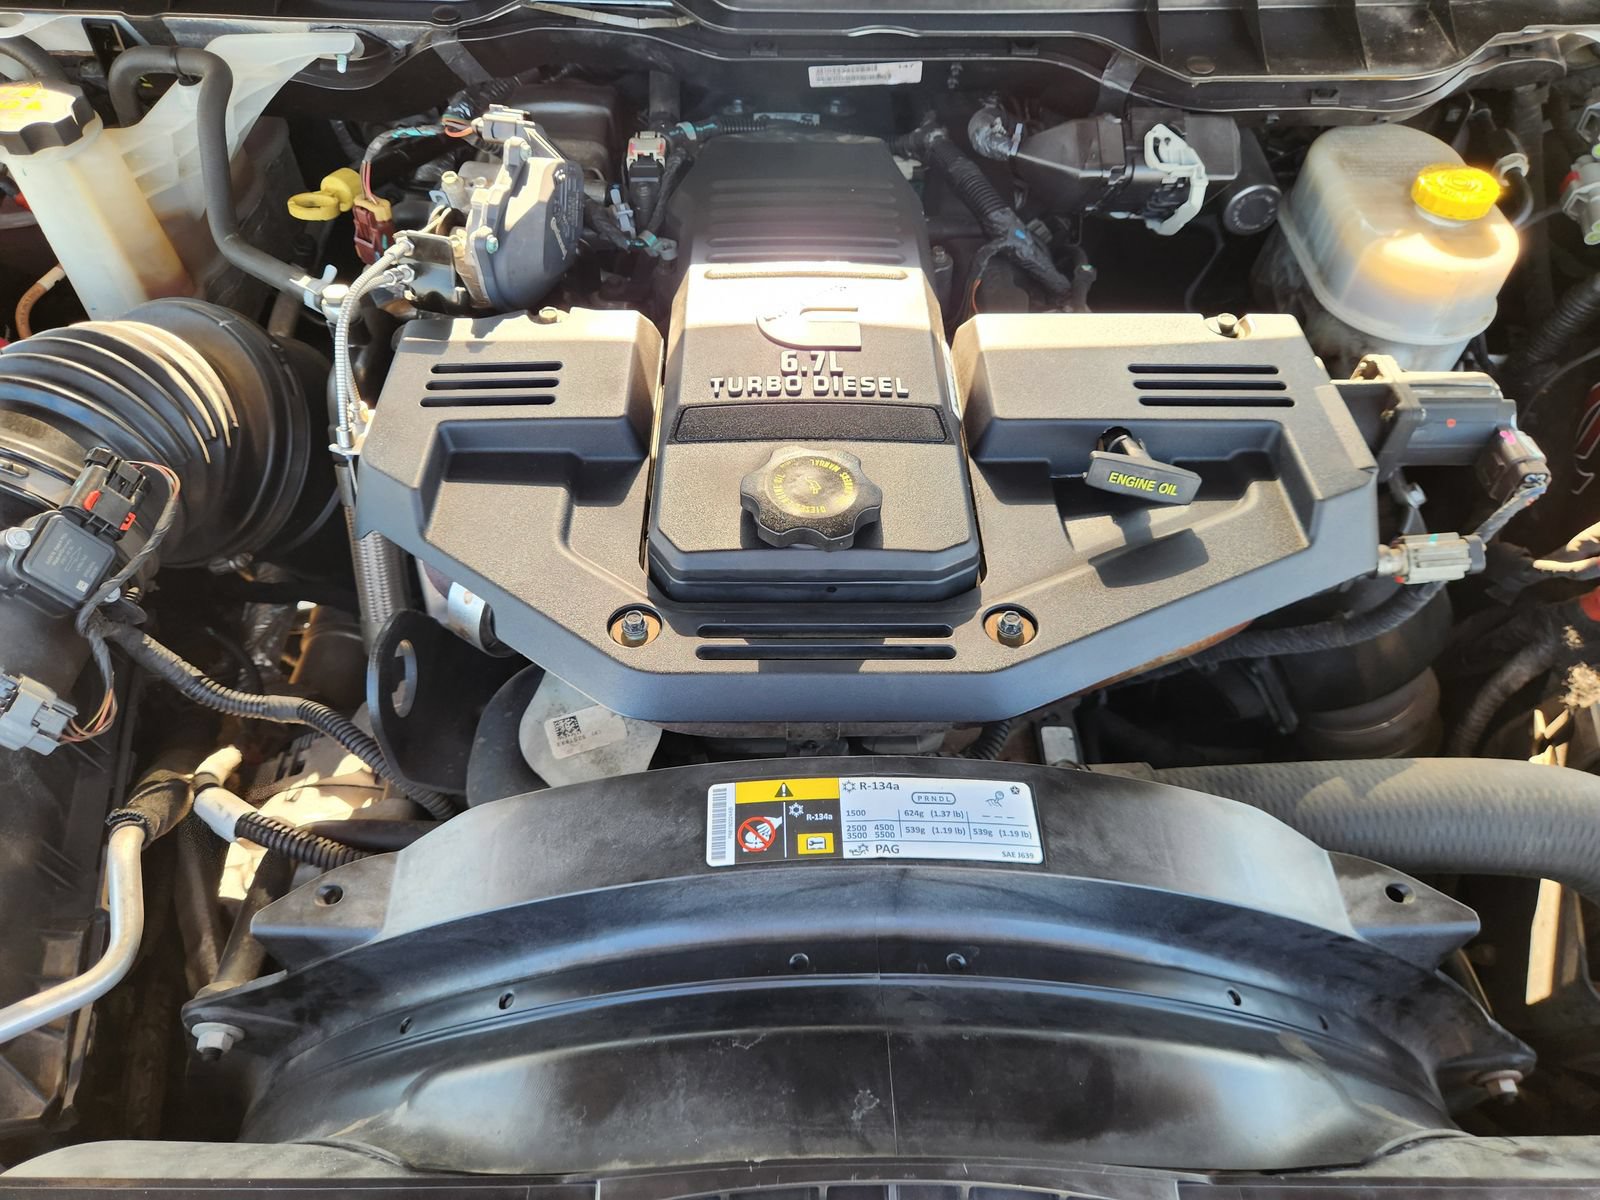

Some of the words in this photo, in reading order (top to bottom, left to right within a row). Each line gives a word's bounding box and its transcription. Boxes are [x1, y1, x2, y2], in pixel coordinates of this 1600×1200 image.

[780, 350, 844, 376] 6.7L
[710, 375, 803, 398] TURBO
[812, 375, 909, 398] DIESEL
[1108, 471, 1157, 492] ENGINE
[1158, 482, 1178, 496] OIL
[859, 781, 900, 791] R-134a
[806, 813, 833, 821] R-134a
[846, 809, 866, 817] 1500
[904, 809, 924, 818] 624g
[930, 810, 951, 818] (1.37
[953, 810, 964, 819] lb)
[846, 824, 867, 832] 2500
[874, 823, 895, 831] 4500
[905, 826, 925, 835] 539g
[931, 827, 952, 835] (1.19
[954, 827, 966, 836] lb)
[972, 828, 993, 837] 539g
[999, 829, 1019, 838] (1.19
[1021, 830, 1032, 839] lb)
[847, 832, 867, 840] 3500
[874, 831, 895, 839] 5500
[875, 844, 900, 854] PAG
[1001, 850, 1016, 858] SAE
[1018, 852, 1035, 860] J639
